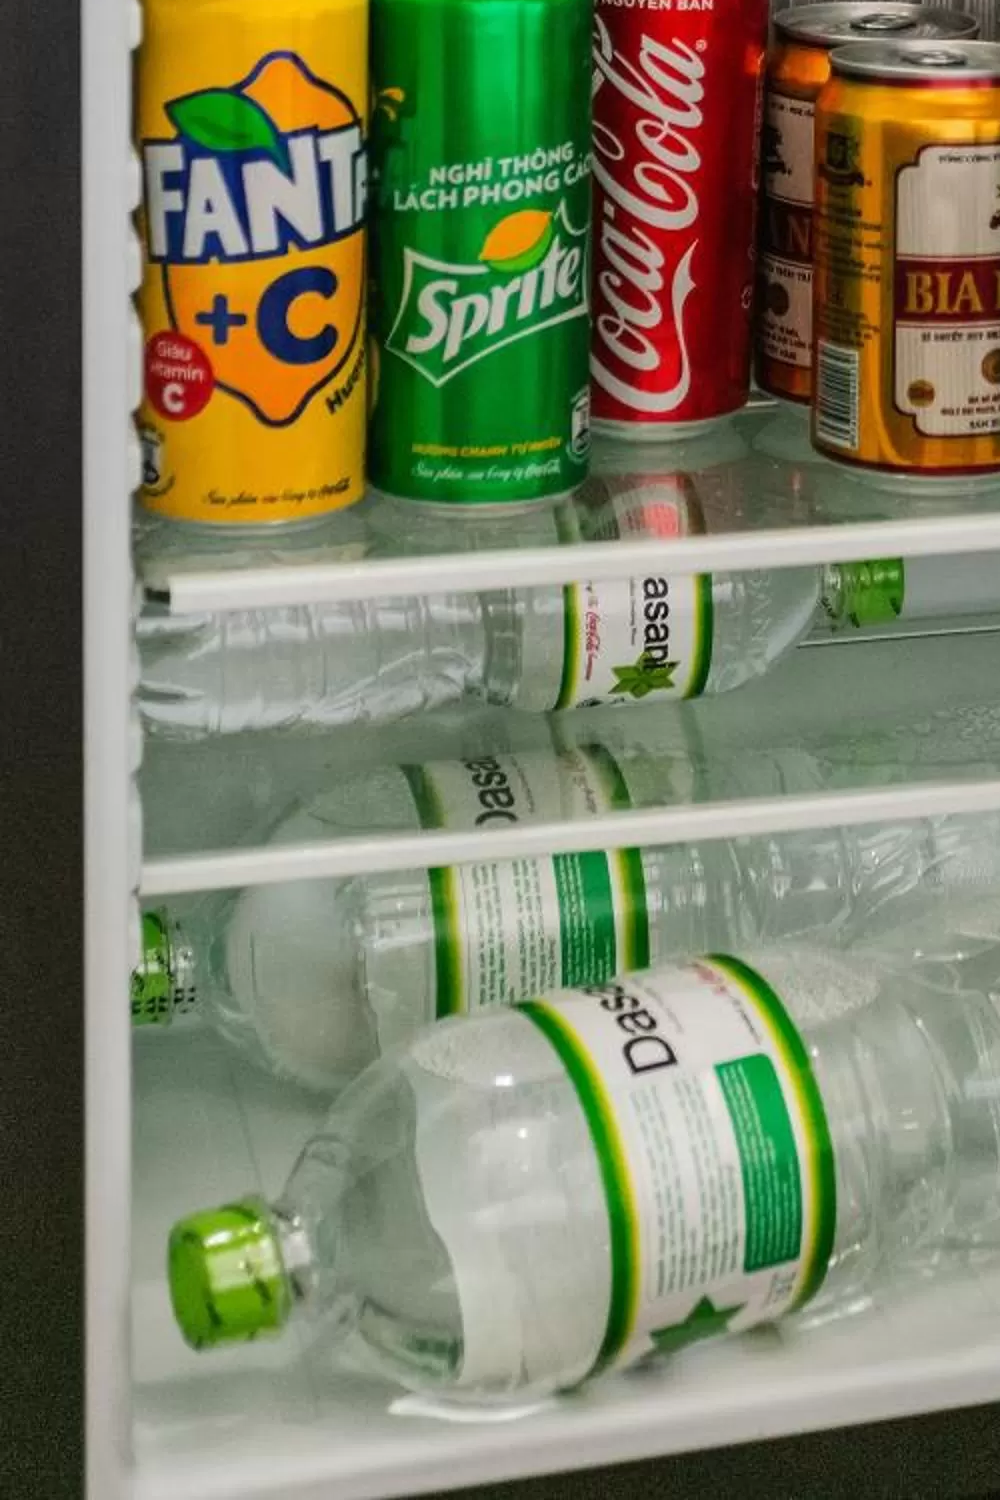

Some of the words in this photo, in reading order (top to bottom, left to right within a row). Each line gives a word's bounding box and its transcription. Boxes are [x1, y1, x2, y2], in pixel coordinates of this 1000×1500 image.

[463, 171, 559, 207] PHONG
[563, 153, 592, 186] CÁC
[590, 13, 706, 412] Coca-Cola
[405, 236, 580, 363] Sprite
[905, 269, 984, 315] BIA
[162, 381, 188, 414] C
[643, 577, 672, 670] asani
